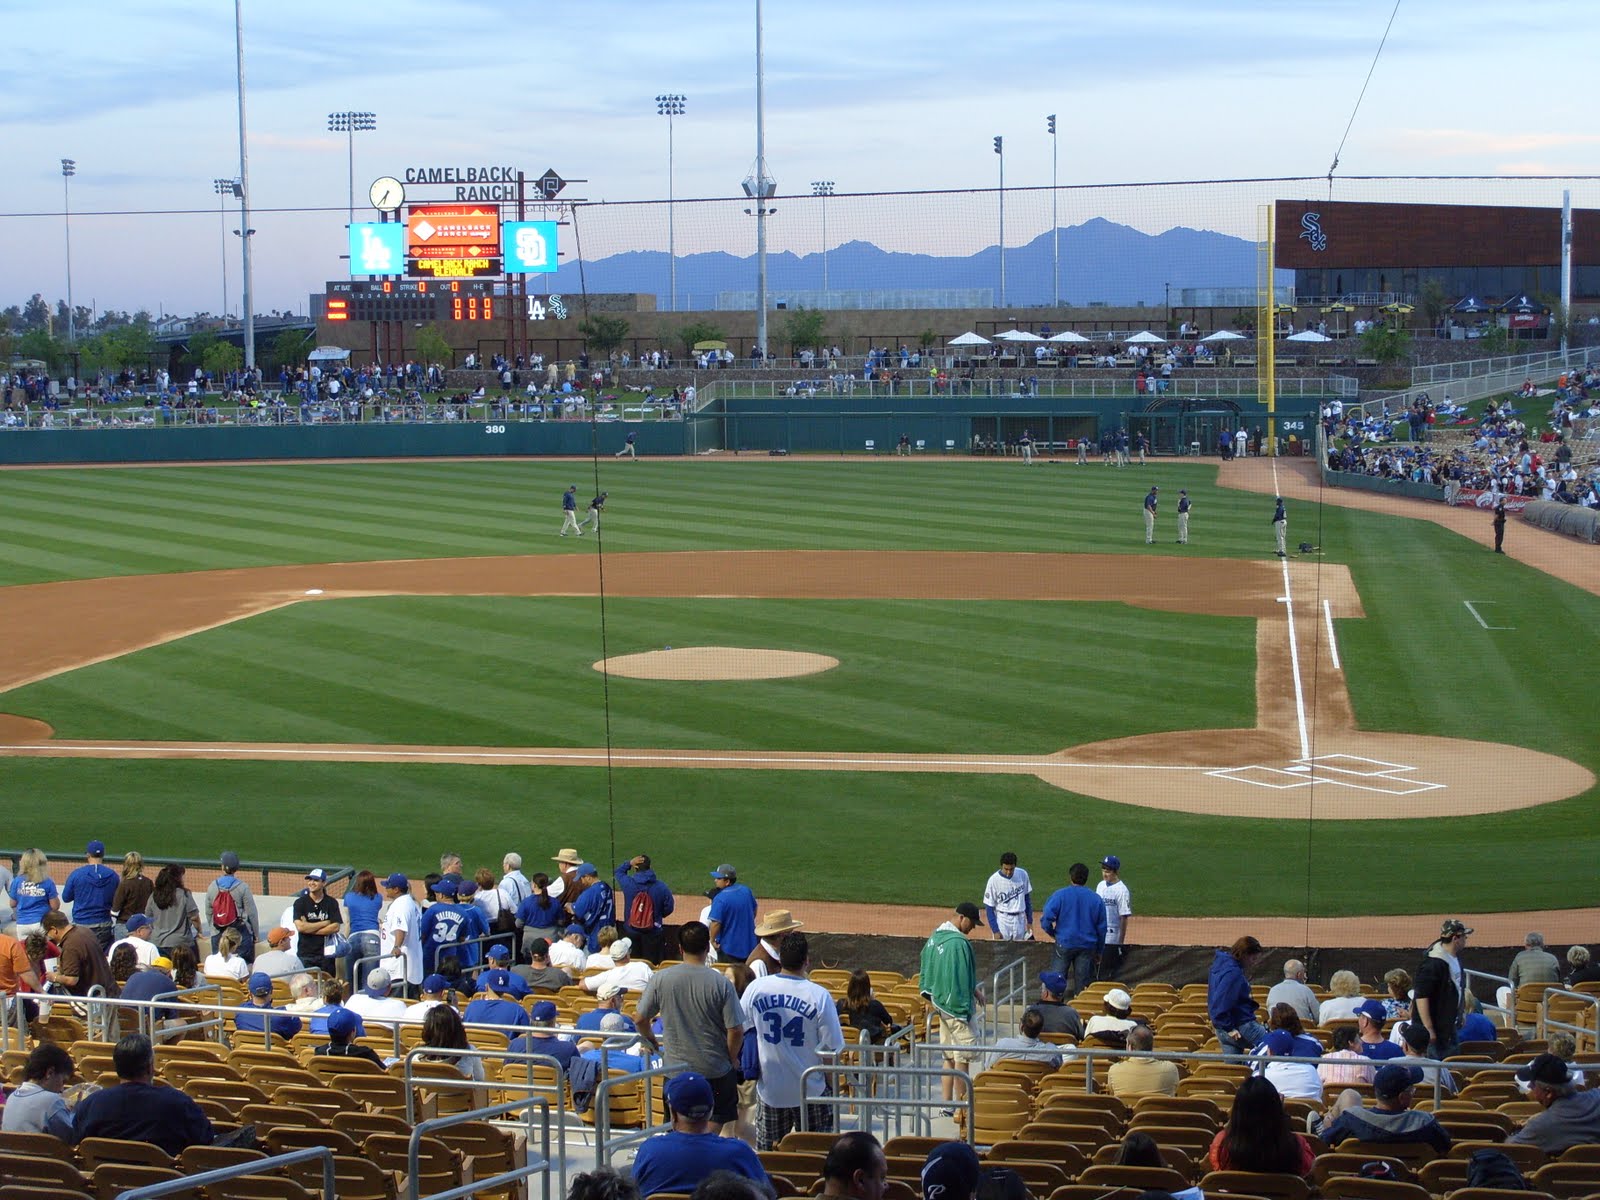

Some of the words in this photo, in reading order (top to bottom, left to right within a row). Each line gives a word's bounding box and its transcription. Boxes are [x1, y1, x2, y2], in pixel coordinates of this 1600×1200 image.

[405, 167, 513, 183] CAMELBACK
[455, 185, 514, 201] RANCH
[516, 227, 548, 267] SD
[418, 259, 463, 269] CAMELBACK
[464, 259, 490, 269] RANCH
[433, 267, 475, 277] GLENDALE
[383, 281, 391, 293] 0
[400, 283, 418, 291] STRIKE
[418, 281, 426, 292] 0
[451, 281, 458, 292] 0
[454, 298, 461, 309] 0
[469, 298, 476, 309] 0
[484, 298, 491, 309] 0
[528, 294, 546, 320] LA
[454, 309, 461, 320] 0
[469, 309, 476, 320] 0
[484, 309, 491, 320] 0
[485, 425, 505, 434] 380
[1283, 421, 1304, 430] 345
[435, 911, 464, 924] VALENZUELA
[432, 922, 460, 942] 34
[752, 994, 818, 1020] VALENZUELA
[763, 1011, 805, 1047] 34
